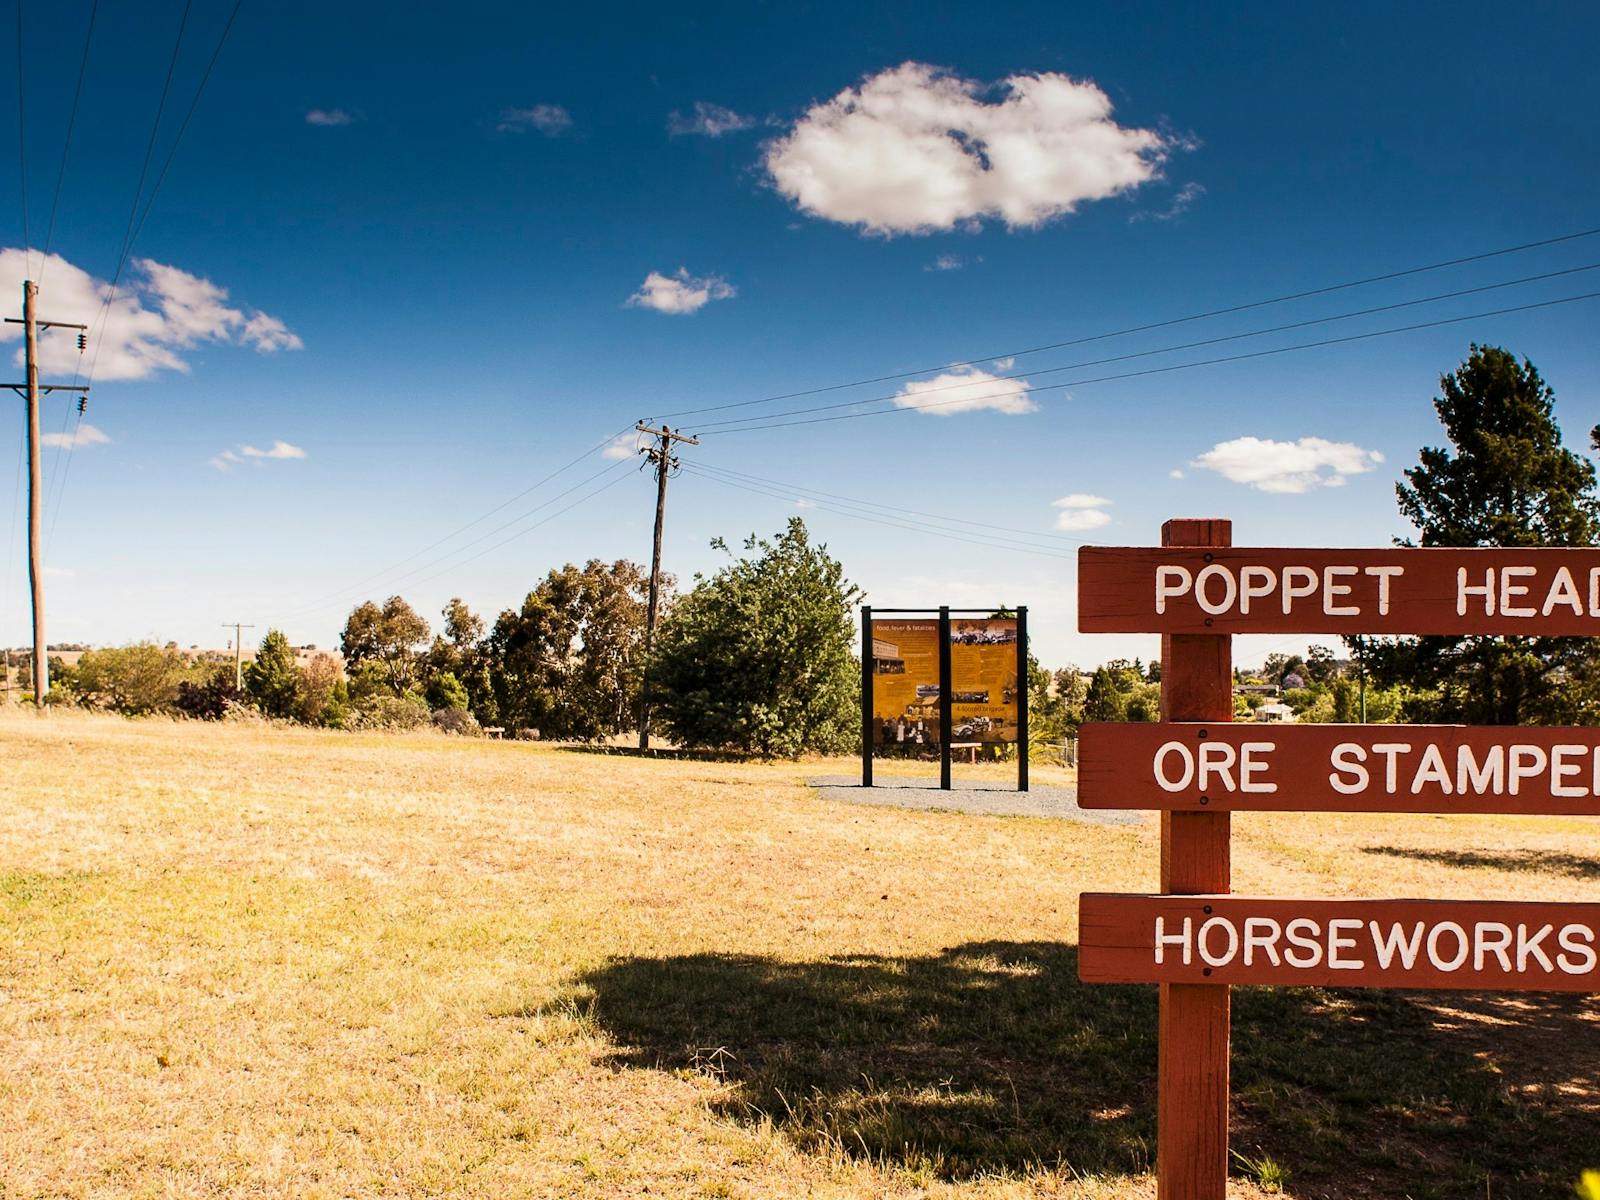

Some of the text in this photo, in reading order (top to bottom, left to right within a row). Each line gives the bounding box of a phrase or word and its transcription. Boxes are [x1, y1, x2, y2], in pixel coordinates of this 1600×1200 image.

[1156, 565, 1404, 615] POPPET
[1154, 742, 1600, 797] ORE STAMPE
[1154, 917, 1597, 974] HORSEWORKS
